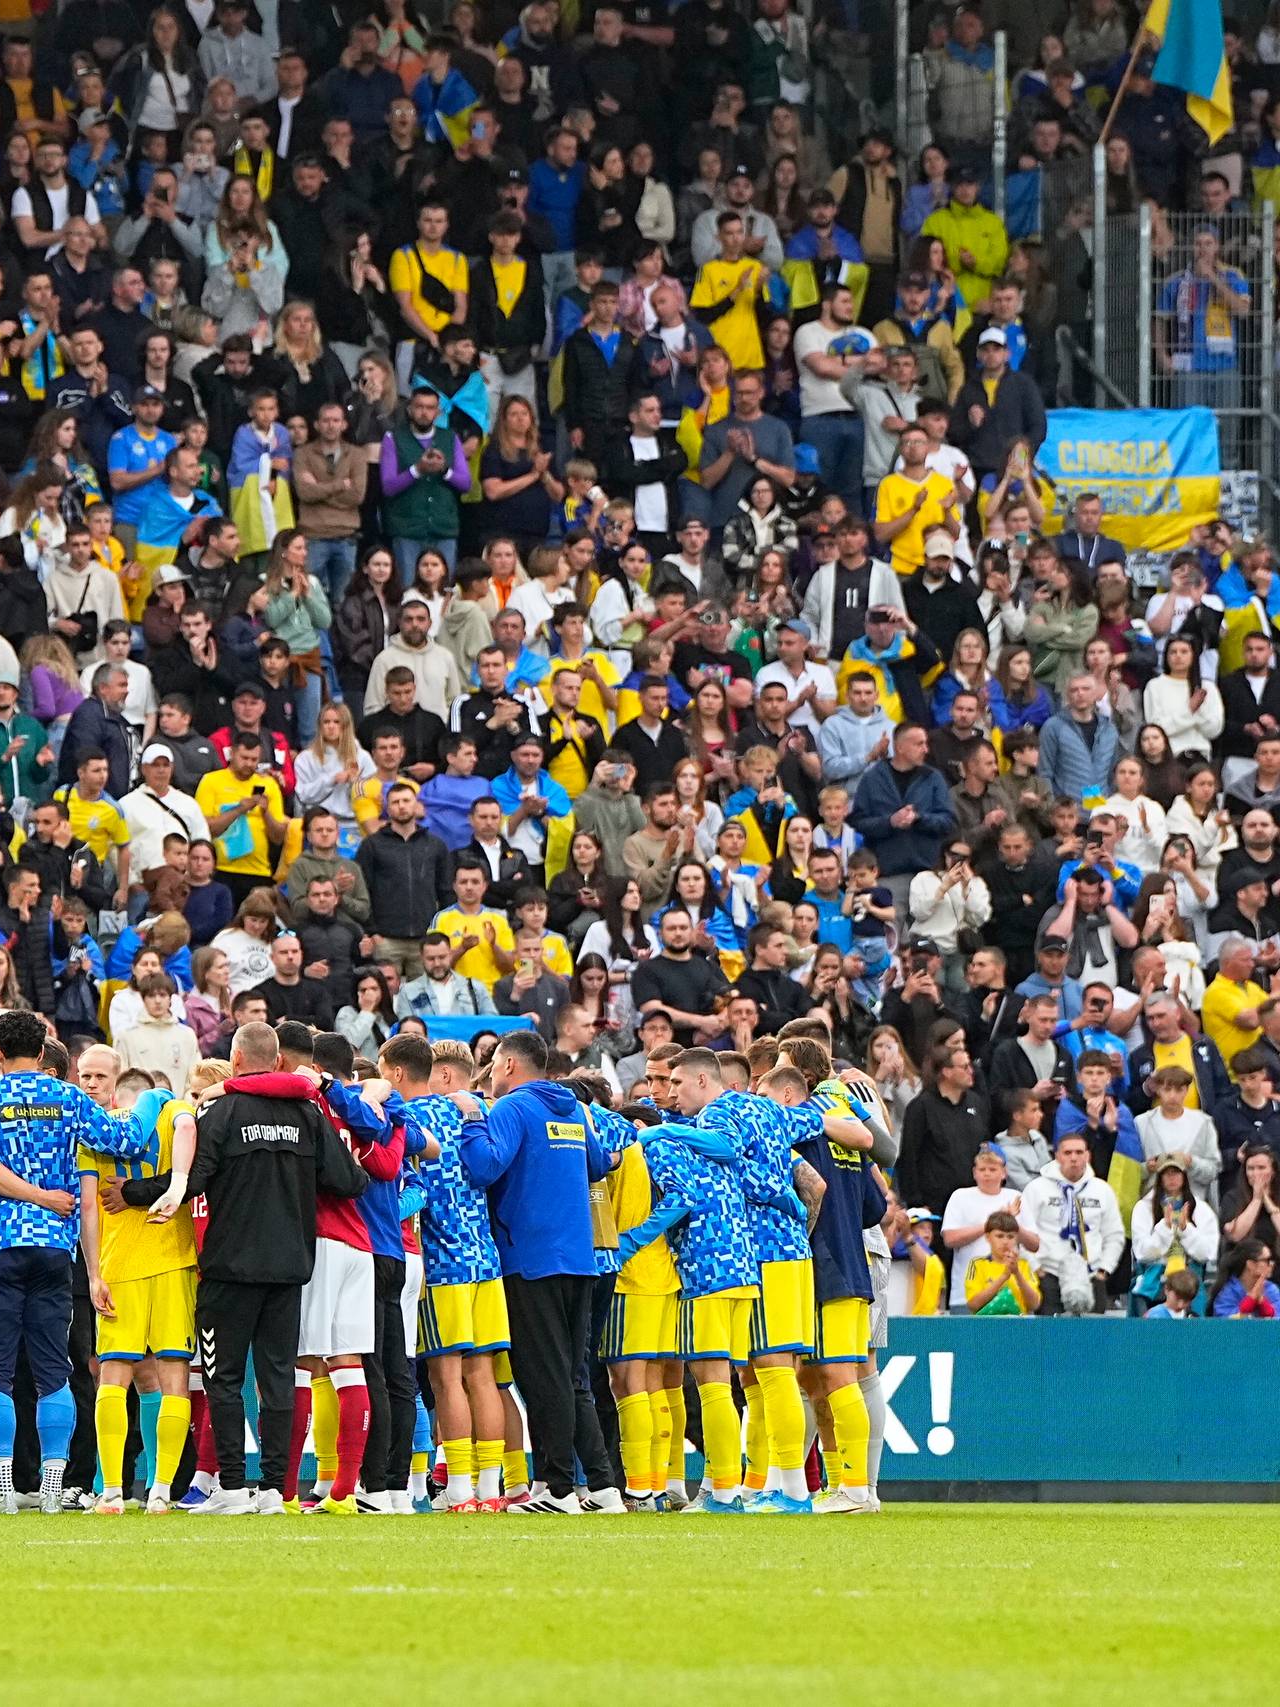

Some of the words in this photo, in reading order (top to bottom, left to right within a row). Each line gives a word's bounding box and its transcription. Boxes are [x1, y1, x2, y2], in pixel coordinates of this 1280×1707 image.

[1058, 440, 1173, 475] СЛОБОДА
[240, 1123, 262, 1143] FOR
[191, 1192, 208, 1218] 12
